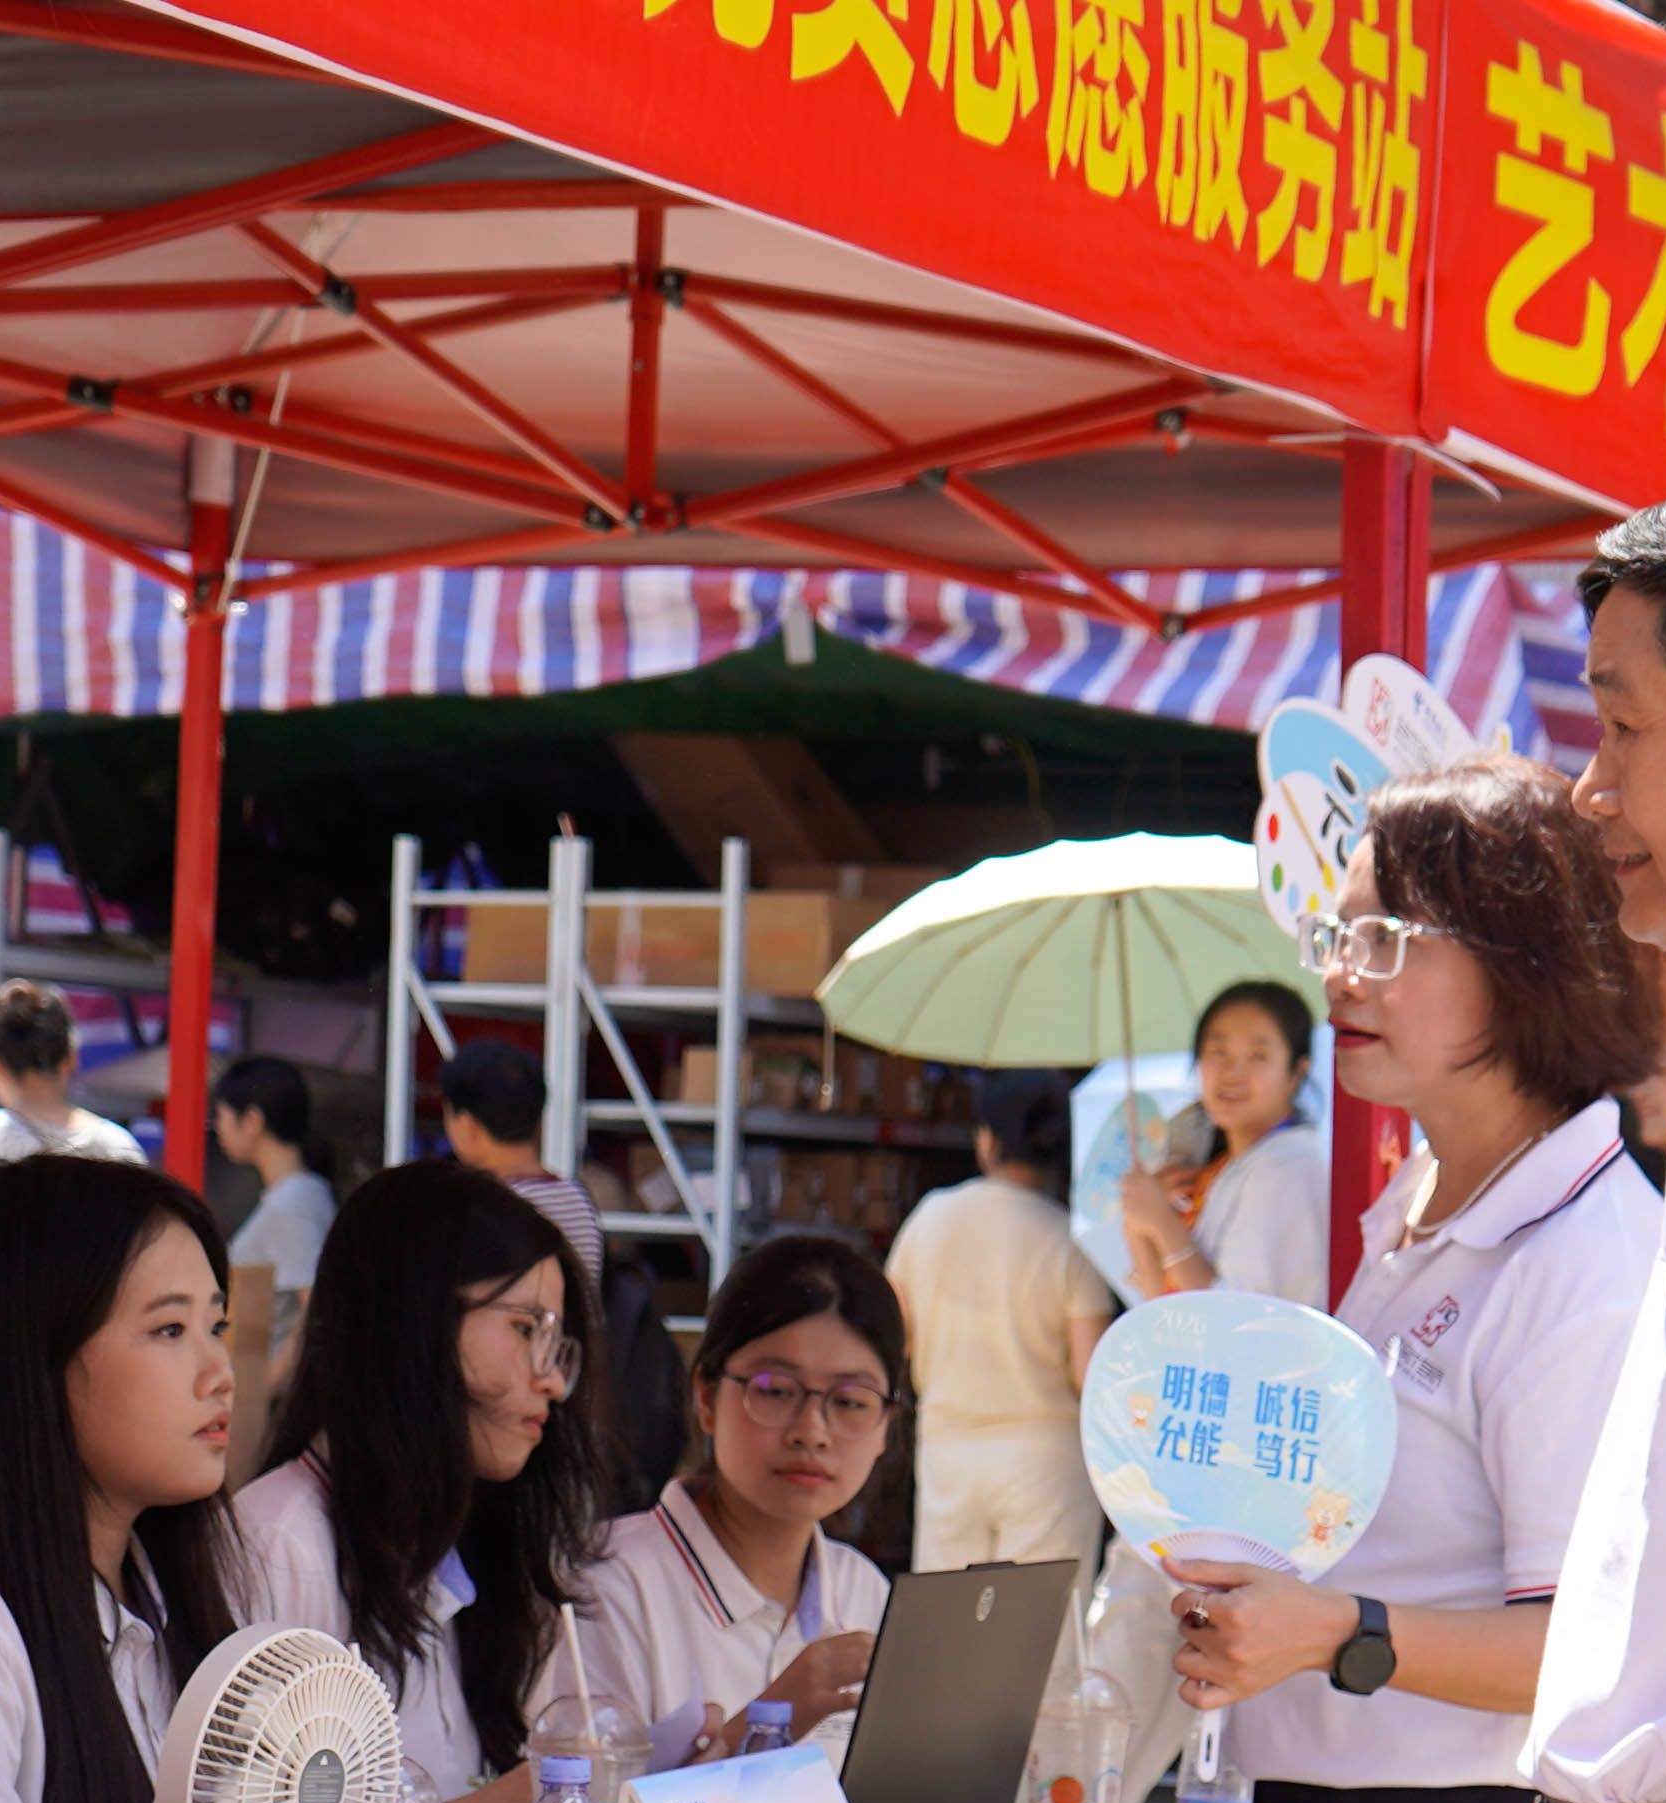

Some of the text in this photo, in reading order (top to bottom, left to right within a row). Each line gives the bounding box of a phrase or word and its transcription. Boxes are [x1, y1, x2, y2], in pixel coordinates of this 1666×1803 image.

[1161, 1364, 1323, 1435] 明德 诚信
[1154, 1414, 1321, 1484] 允能 笃行
